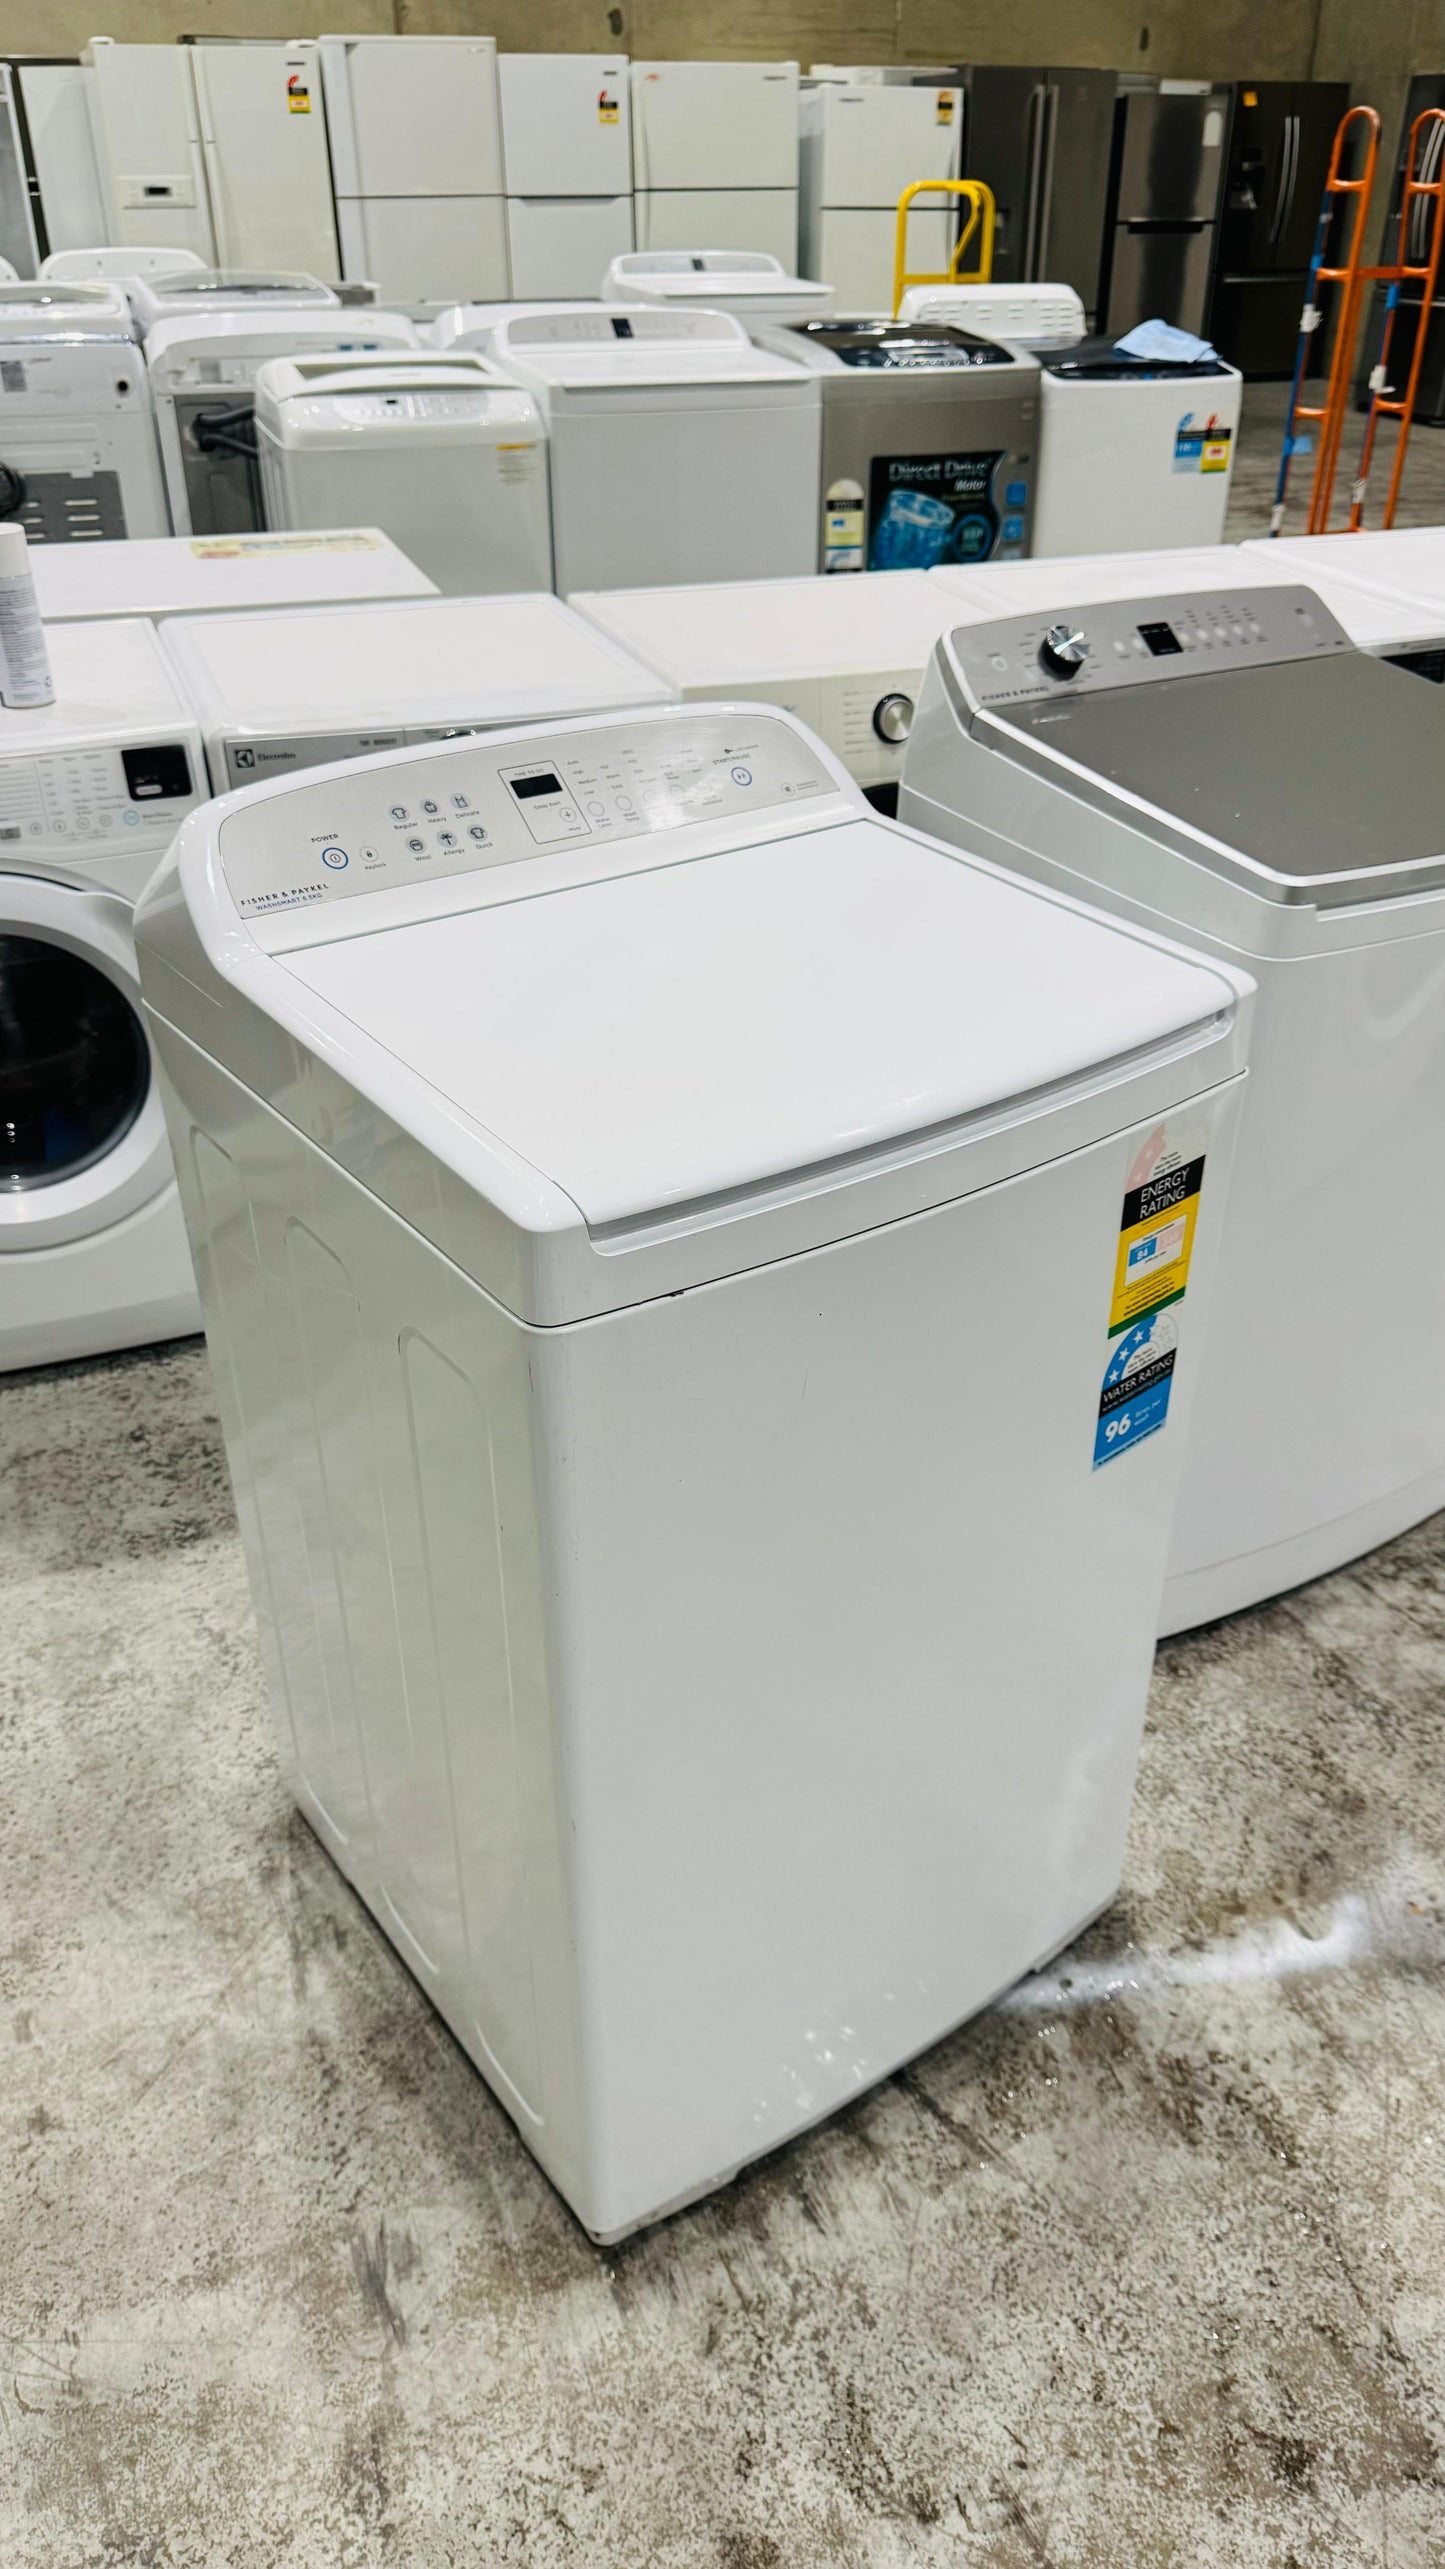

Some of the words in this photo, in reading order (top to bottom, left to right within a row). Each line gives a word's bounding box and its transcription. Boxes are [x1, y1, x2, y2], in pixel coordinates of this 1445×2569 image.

[888, 462, 941, 481] Direct
[944, 459, 988, 480] Drive
[257, 751, 296, 762] Electrolux
[455, 809, 480, 819] Delicate
[393, 821, 419, 831] Regular
[311, 833, 339, 843] POWER
[414, 854, 432, 862] Wool
[240, 893, 278, 906] FISHER
[291, 883, 330, 895] PAYKEL
[255, 897, 301, 911] WASHSMART
[1140, 1167, 1190, 1203] ENERGY
[1140, 1185, 1186, 1219] RATING
[1103, 1377, 1137, 1402] WATER
[1138, 1354, 1174, 1383] RATING
[1105, 1412, 1131, 1443] 96
